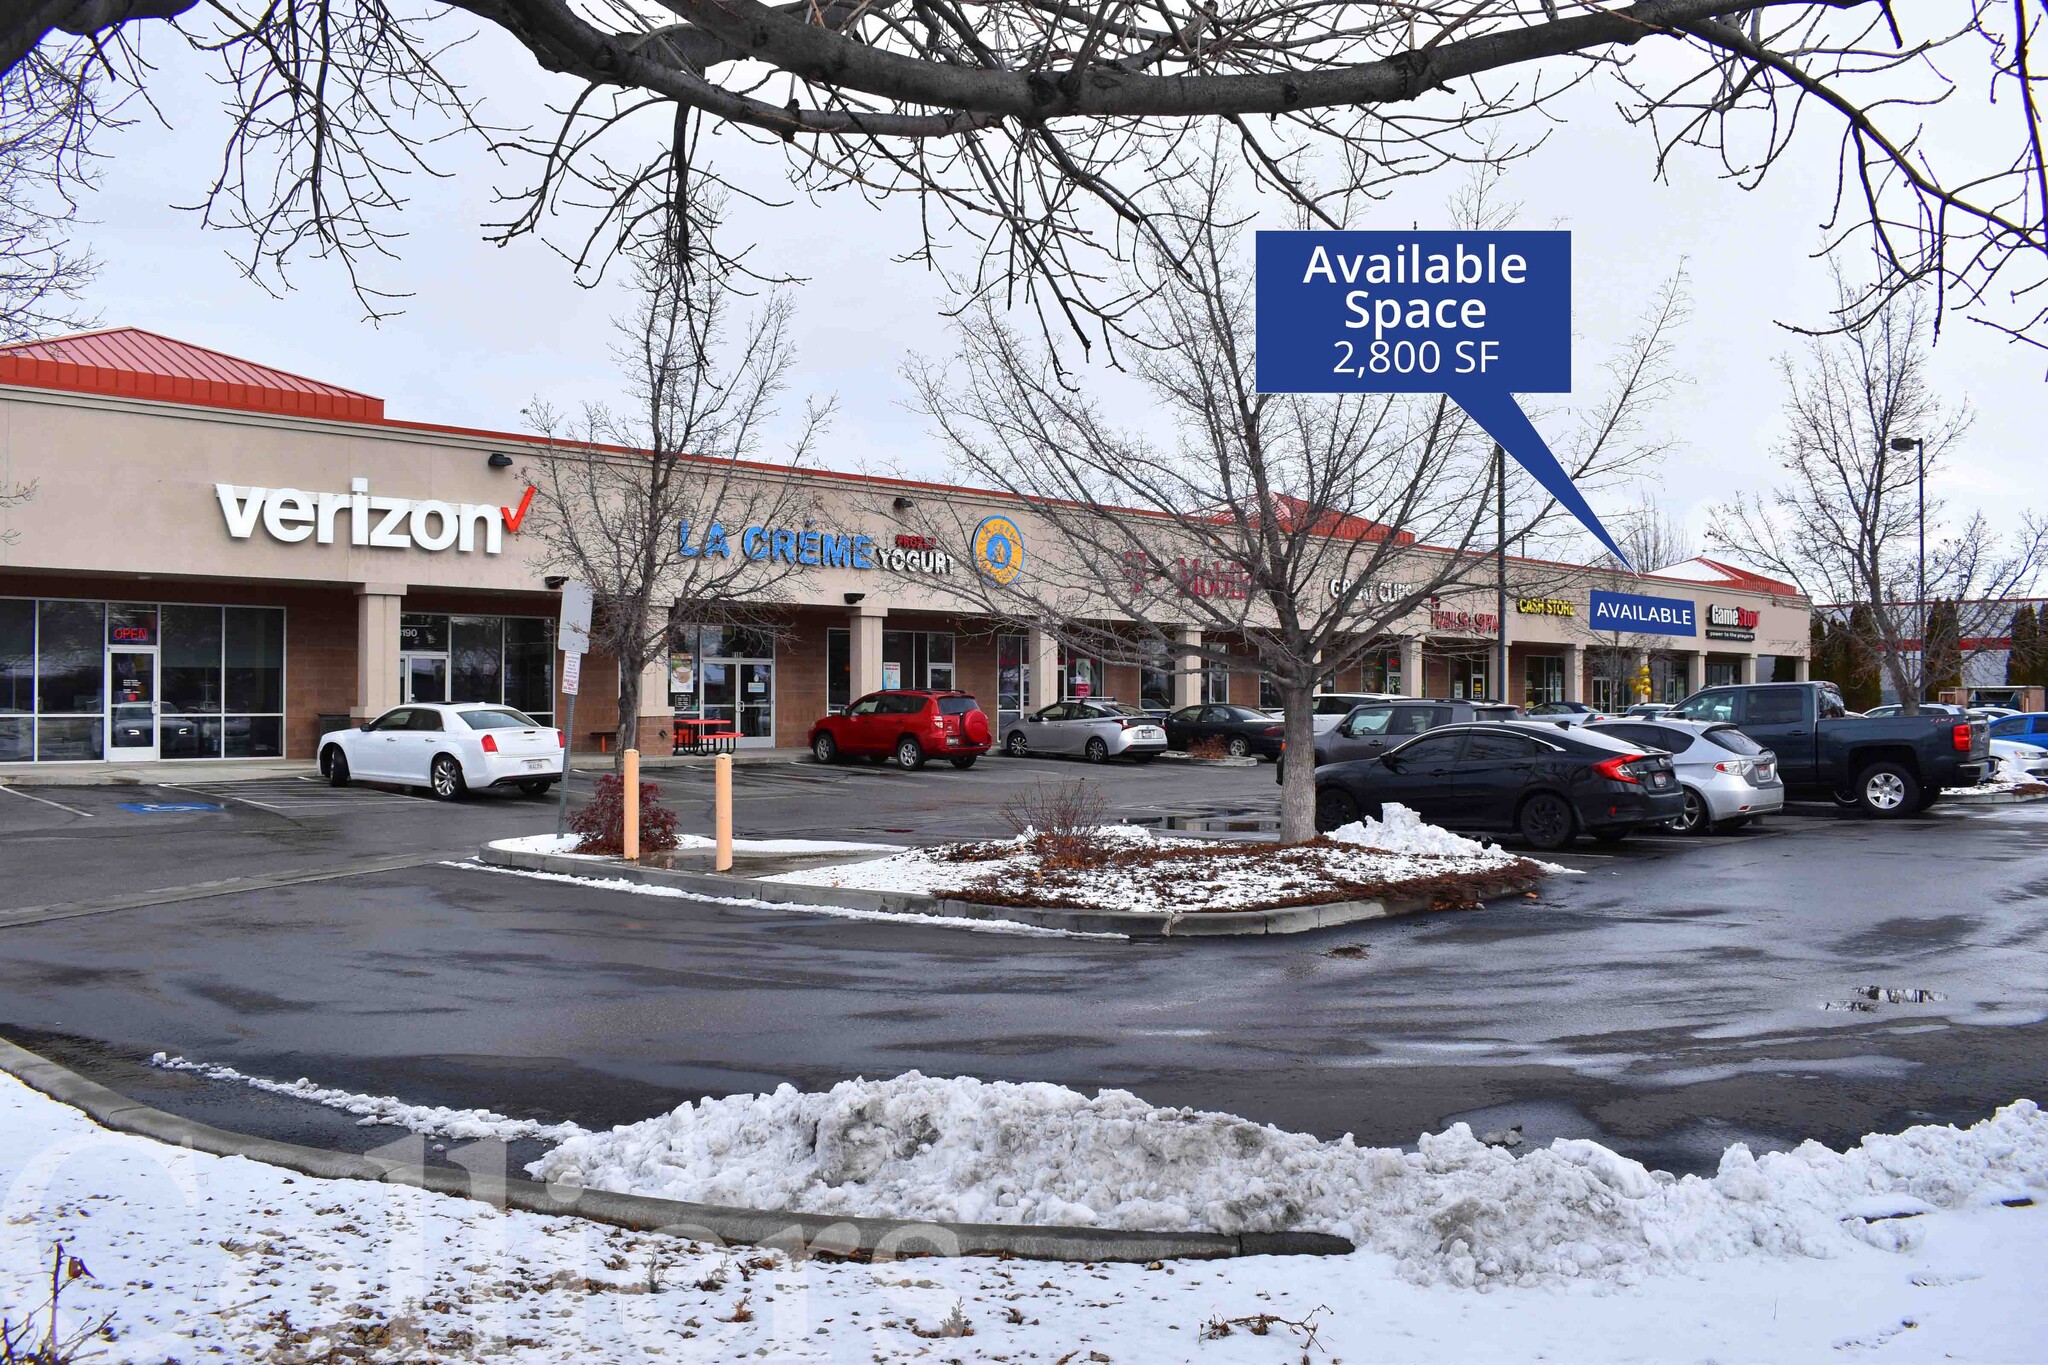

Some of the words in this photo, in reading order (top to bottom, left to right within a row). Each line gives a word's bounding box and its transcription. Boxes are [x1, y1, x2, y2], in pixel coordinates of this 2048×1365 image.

[213, 476, 503, 554] verizon
[677, 519, 730, 560] LA
[876, 548, 955, 576] YOGURT
[1329, 578, 1374, 602] GRAT
[1518, 598, 1546, 614] CASH
[1546, 599, 1576, 617] STORE
[1711, 604, 1760, 629] GameStop
[114, 628, 147, 640] OPEN
[1476, 613, 1501, 634] SPA
